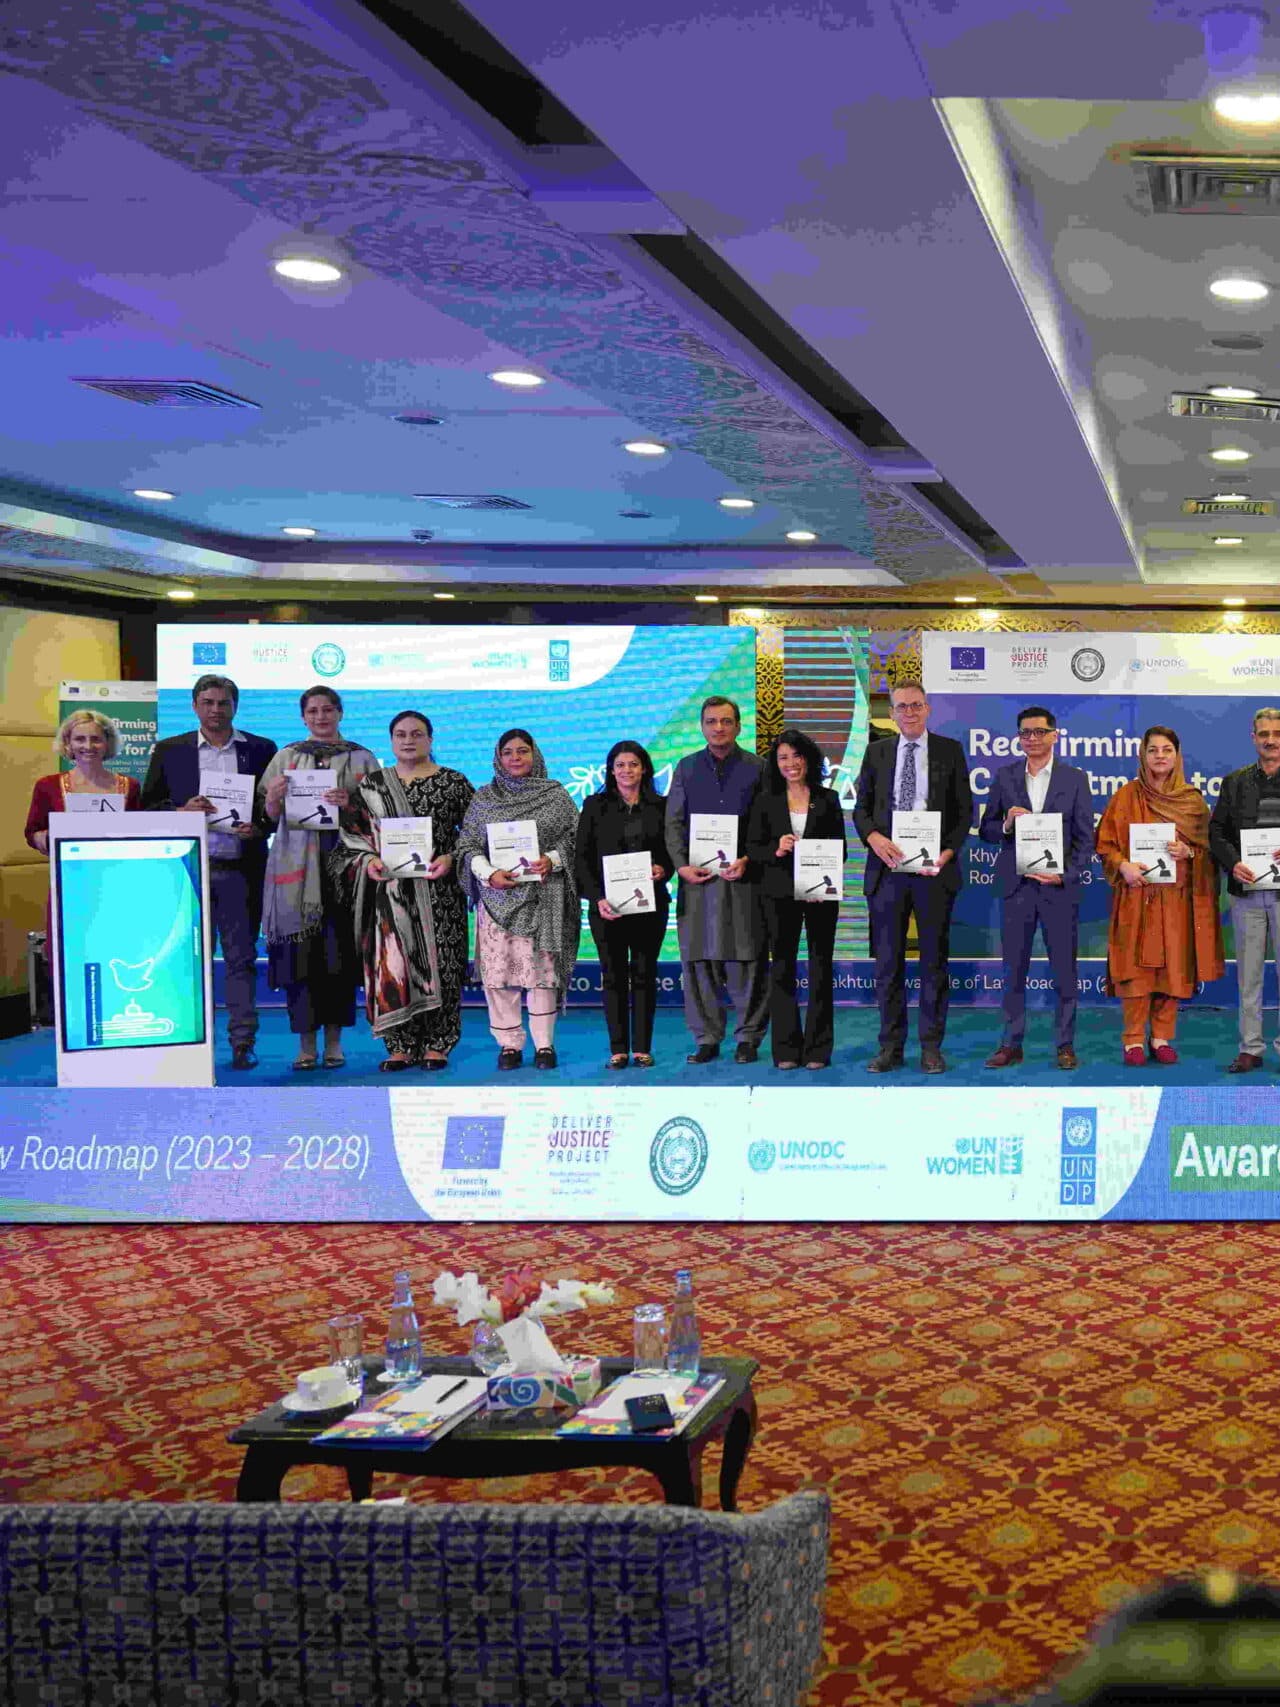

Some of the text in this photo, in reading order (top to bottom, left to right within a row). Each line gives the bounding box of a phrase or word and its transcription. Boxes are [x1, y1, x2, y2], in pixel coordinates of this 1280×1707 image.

[1010, 653, 1048, 662] JUSTICE
[1259, 658, 1274, 667] UN
[1232, 667, 1274, 676] WOMEN
[125, 744, 146, 755] for
[1190, 770, 1223, 797] to
[964, 974, 981, 989] of
[983, 975, 1004, 989] La
[552, 1116, 613, 1129] DELIVER
[548, 1130, 612, 1149] JUSTICE
[972, 1137, 997, 1153] UN
[20, 1134, 159, 1181] Roadmap
[166, 1134, 252, 1181] (2023
[284, 1134, 370, 1181] 2028)
[548, 1150, 610, 1163] PROJECT
[779, 1141, 846, 1160] UNODC
[926, 1157, 996, 1175] WOMEN
